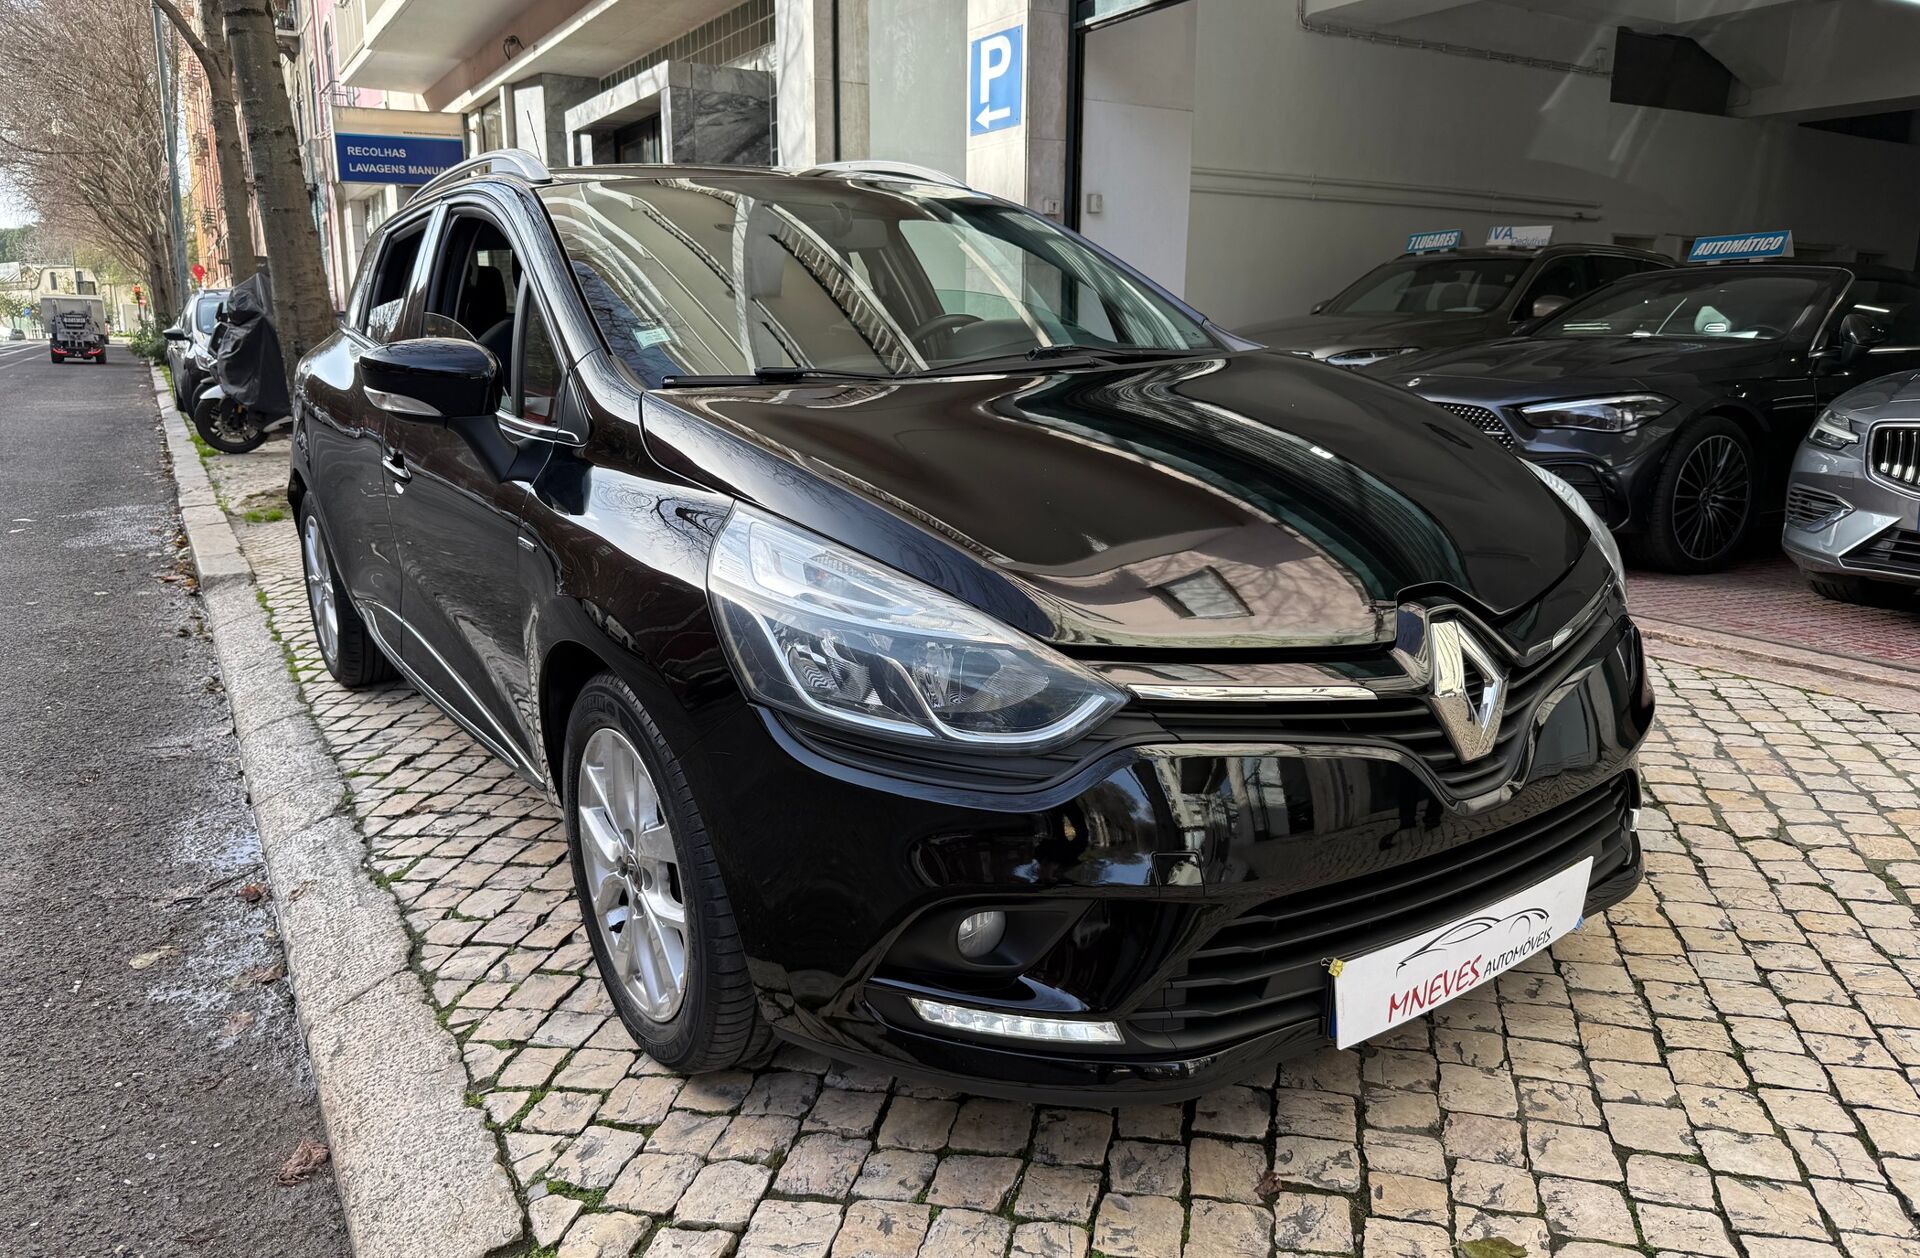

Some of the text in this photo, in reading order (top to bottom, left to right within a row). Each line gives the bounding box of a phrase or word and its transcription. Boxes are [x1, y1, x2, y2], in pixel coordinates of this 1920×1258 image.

[980, 35, 1011, 104] P
[347, 146, 407, 158] RECOLHAS
[349, 163, 450, 175] LAVAGENS MANUA
[1408, 232, 1457, 250] 7 LUGARES
[1488, 225, 1512, 240] IVA
[1693, 236, 1784, 256] AUTOMÁTICO
[1388, 926, 1552, 1023] MNEVES AUTOMÓVEIS
